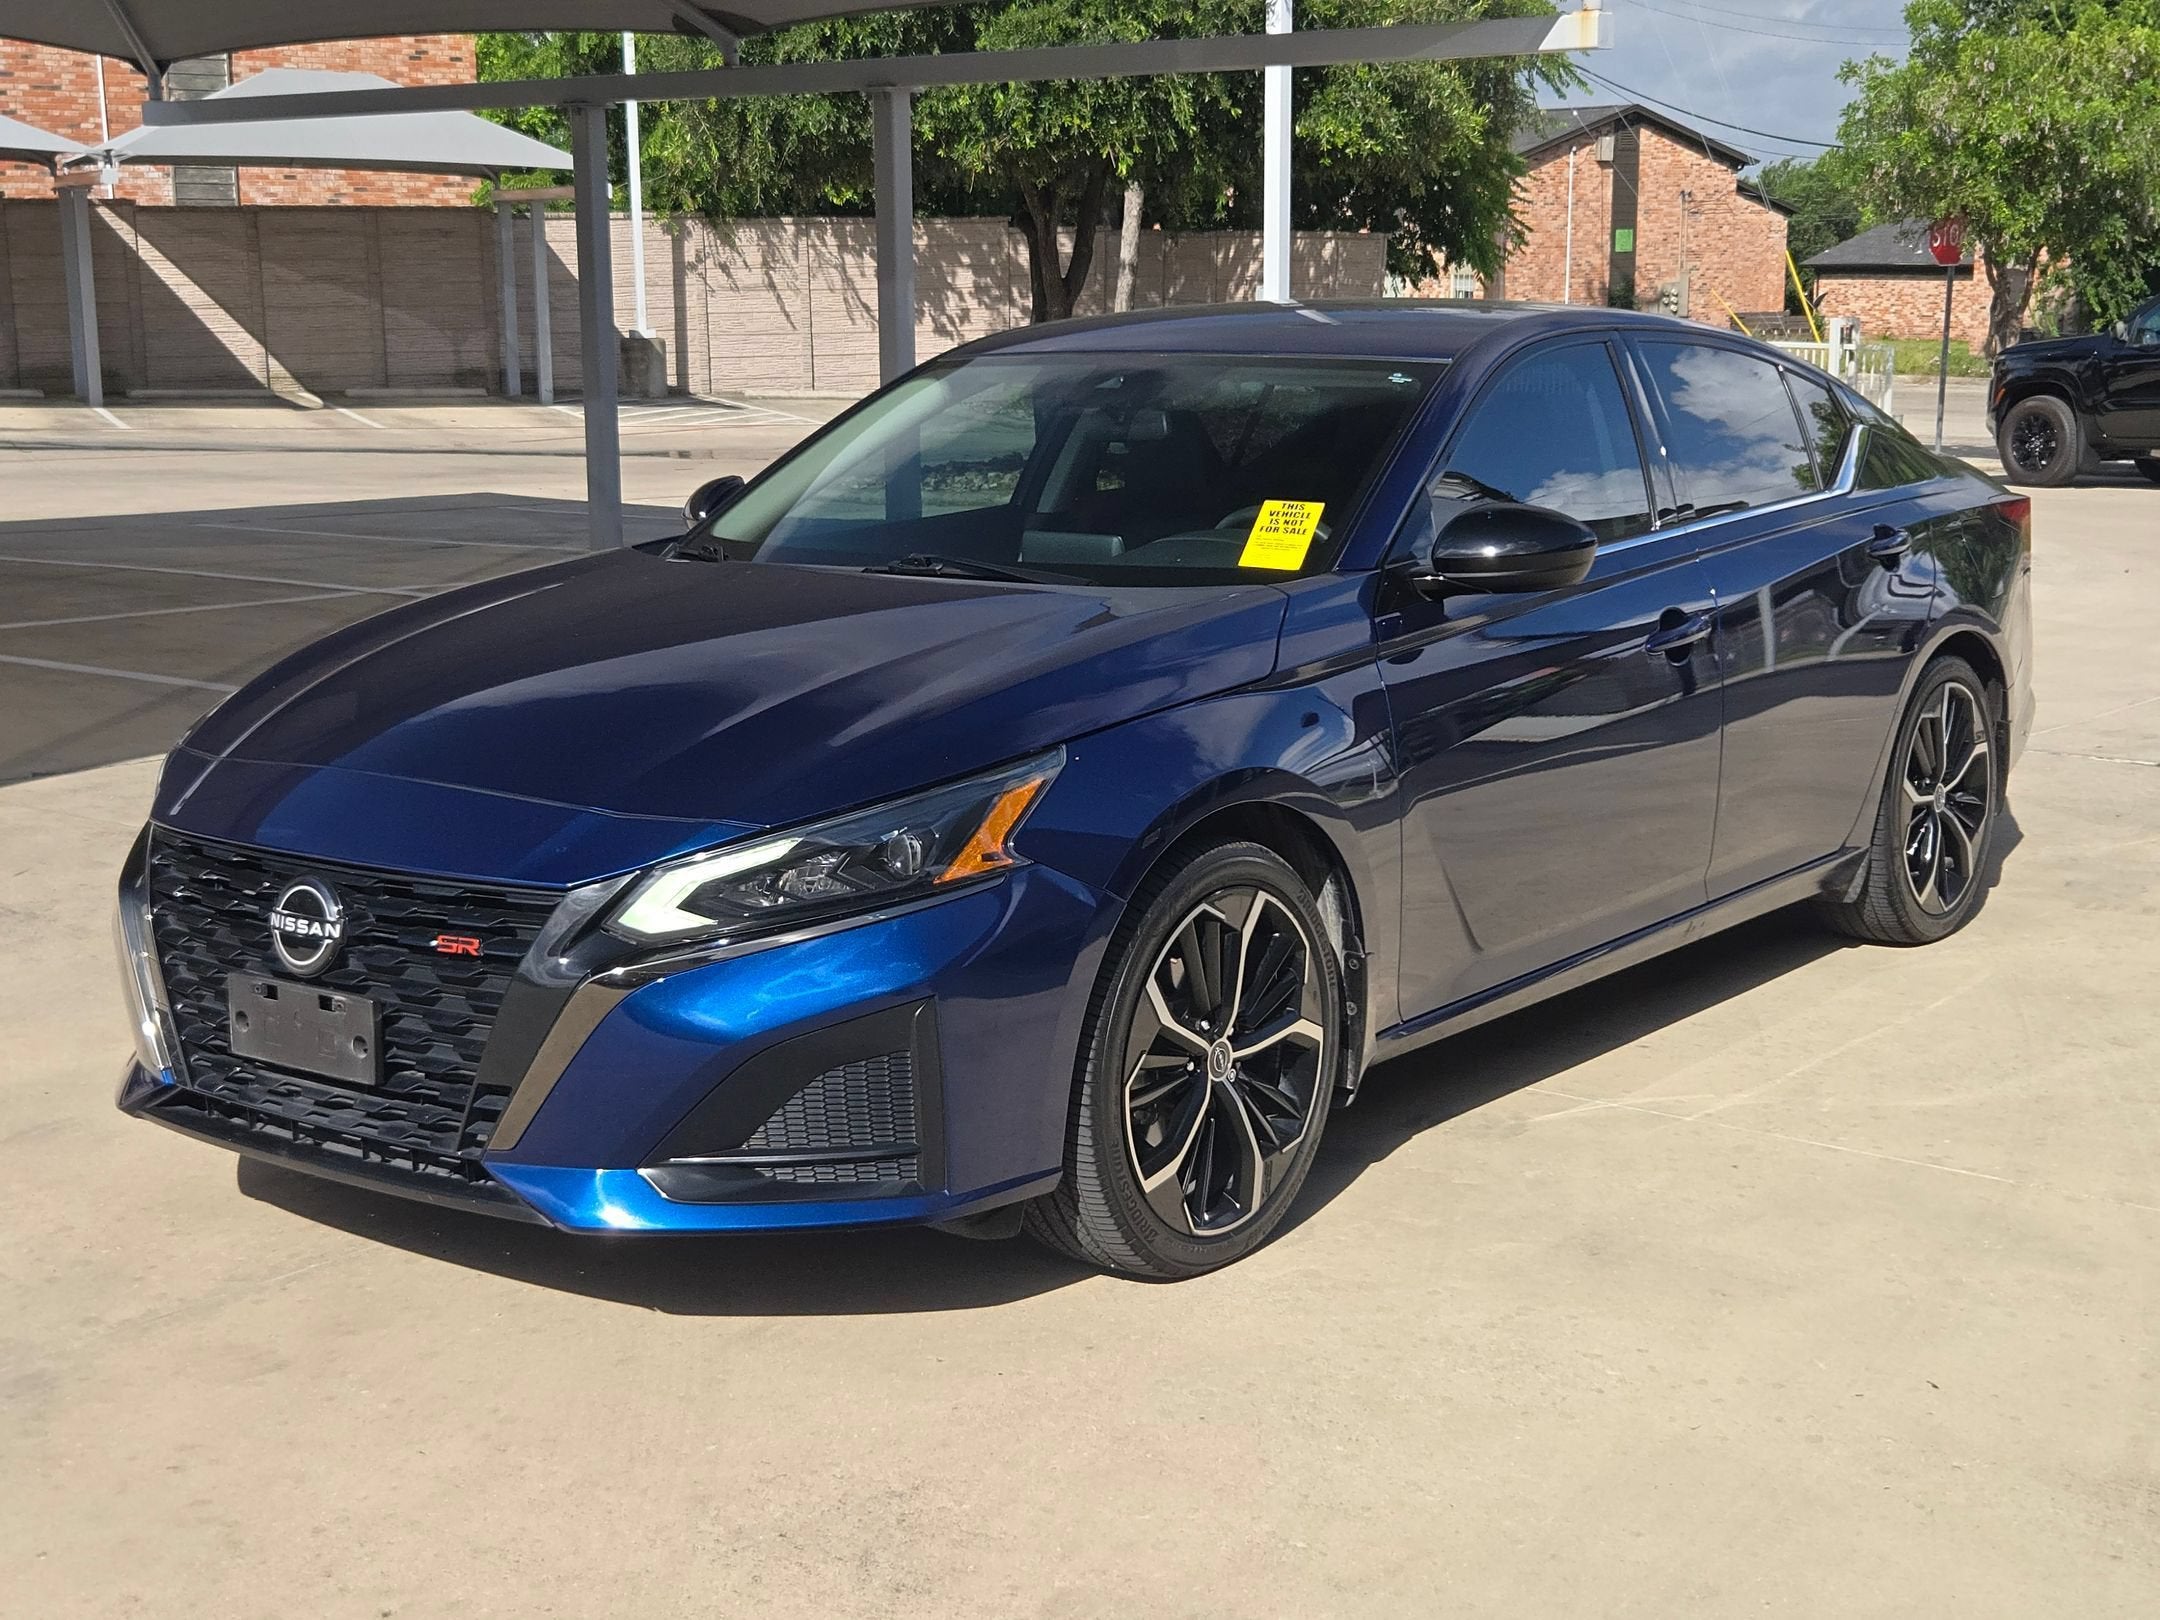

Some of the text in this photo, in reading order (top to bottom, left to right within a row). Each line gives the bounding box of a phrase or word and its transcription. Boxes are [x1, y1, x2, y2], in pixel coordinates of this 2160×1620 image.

[1269, 510, 1311, 519] VEHICLE
[1260, 525, 1308, 536] FOR SALE
[270, 912, 341, 938] NISSAN
[436, 935, 482, 956] SR
